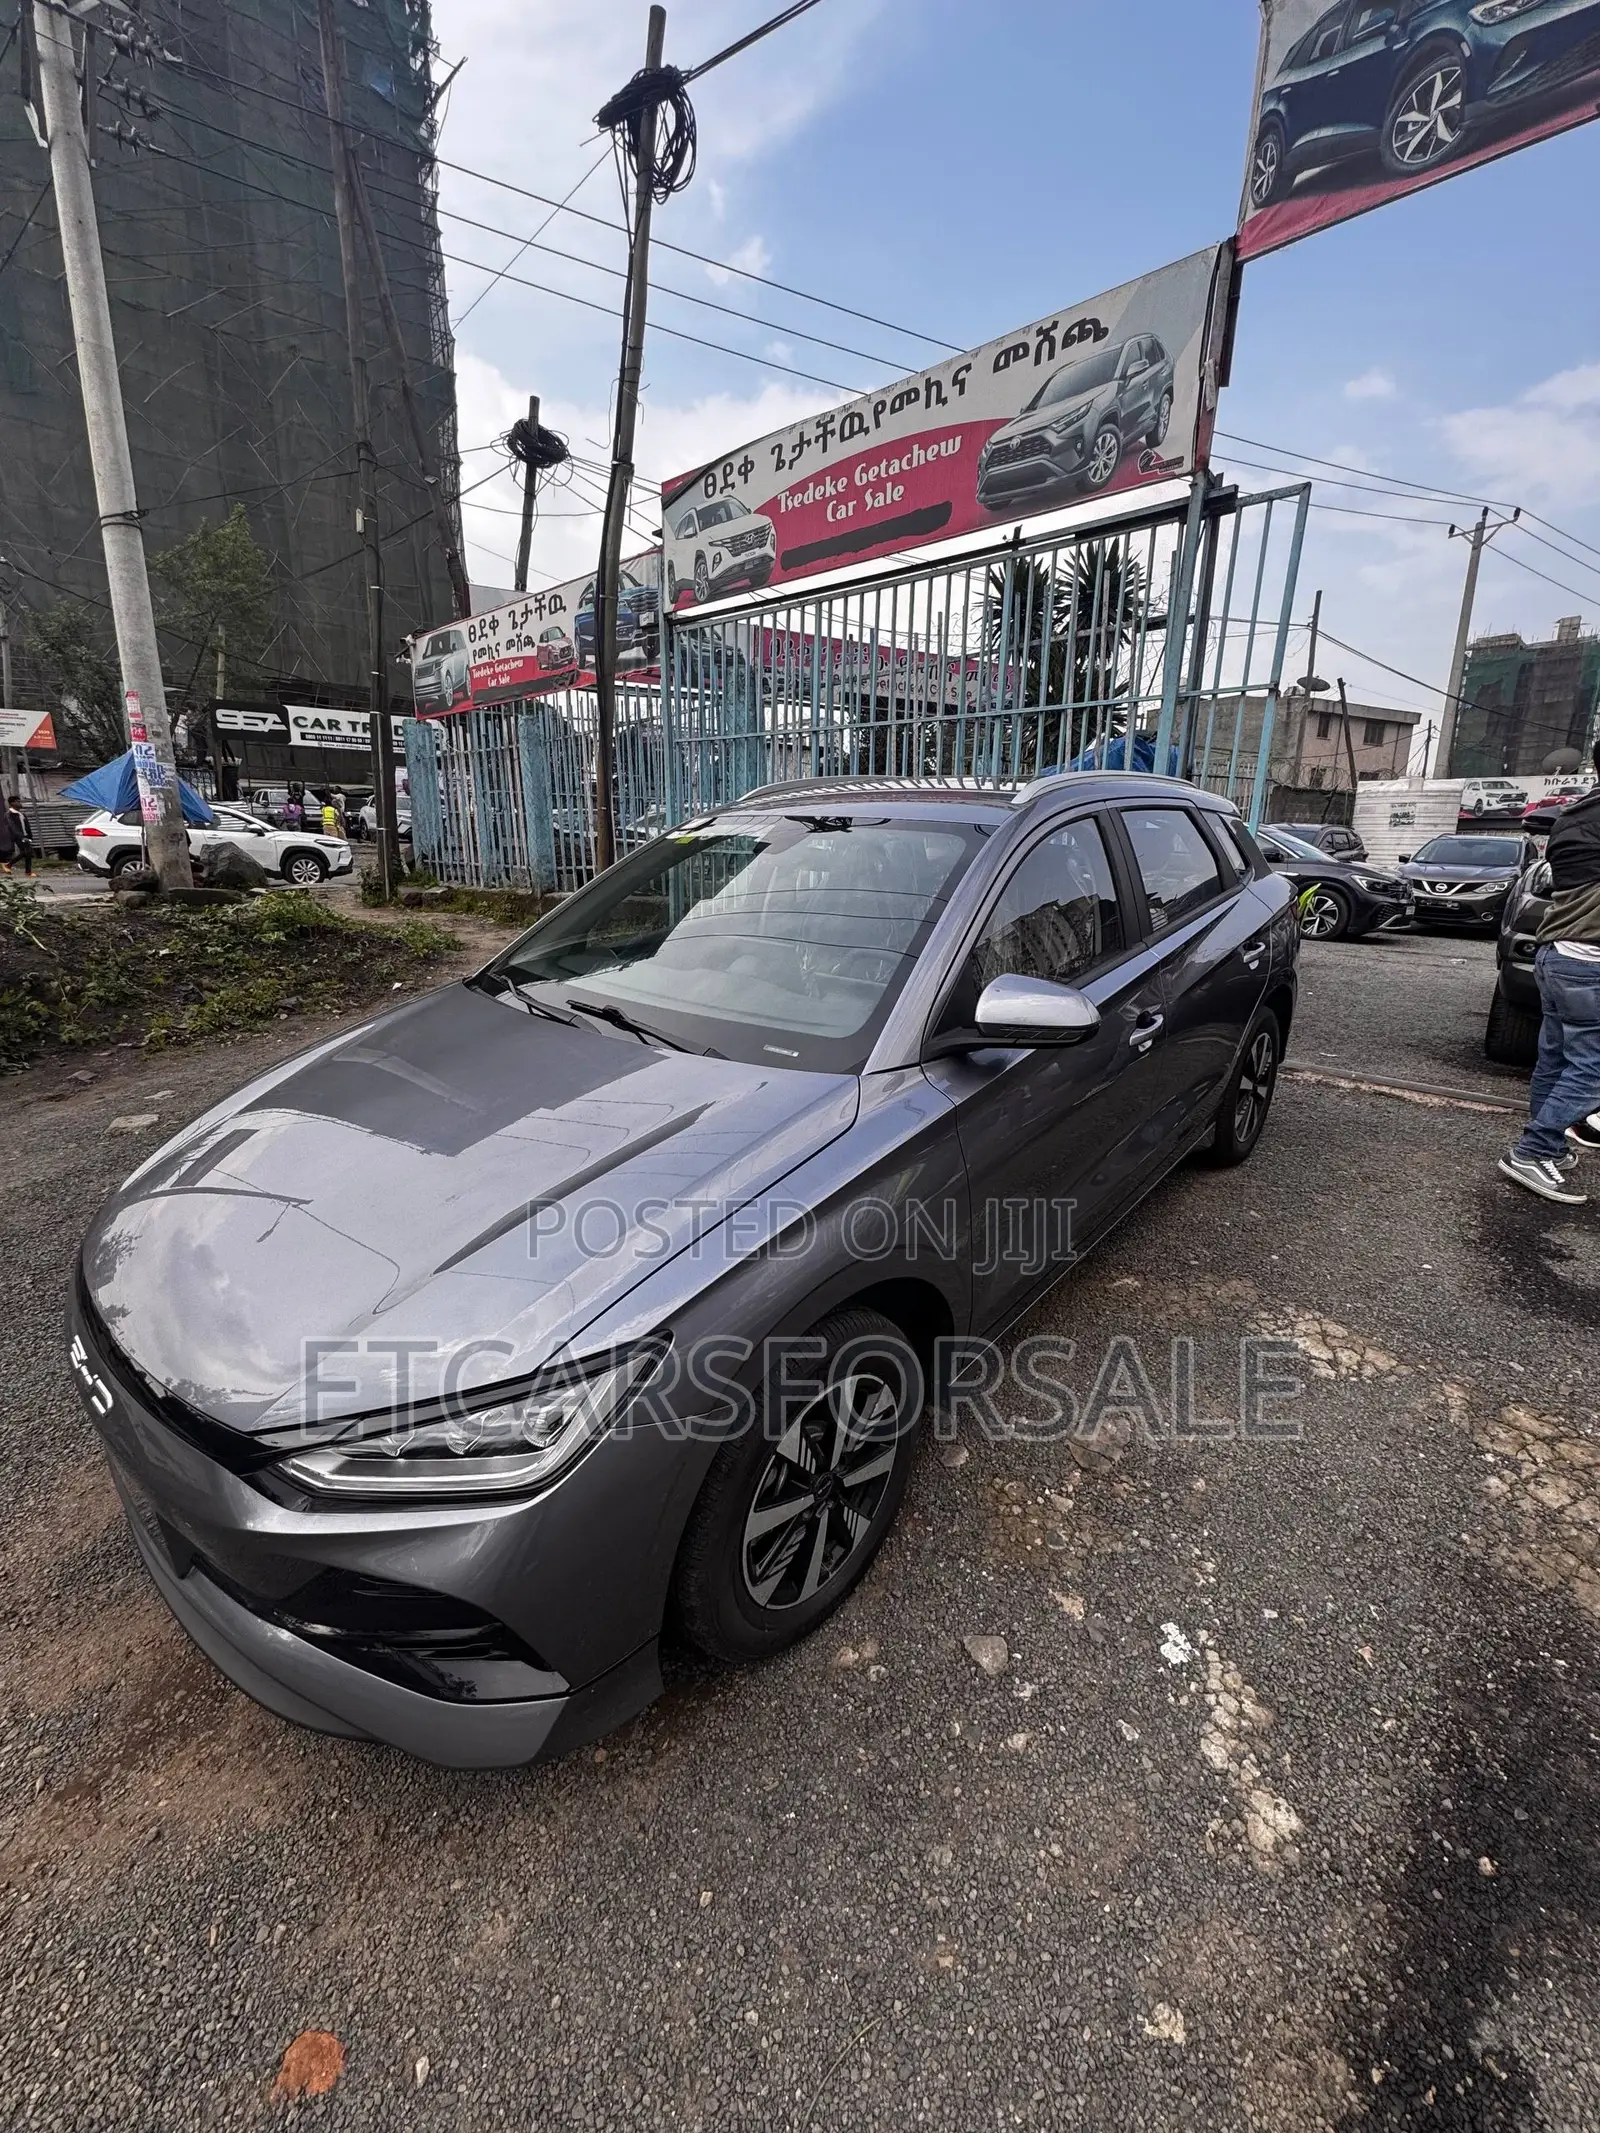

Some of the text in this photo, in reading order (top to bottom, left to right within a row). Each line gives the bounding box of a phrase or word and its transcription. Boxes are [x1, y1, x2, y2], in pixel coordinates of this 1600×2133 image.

[992, 317, 1109, 373] መሸጫ
[777, 435, 963, 514] Tsedeke Getachew
[826, 481, 905, 523] Car Sale
[472, 642, 501, 664] የመኪና
[293, 715, 341, 732] CAR
